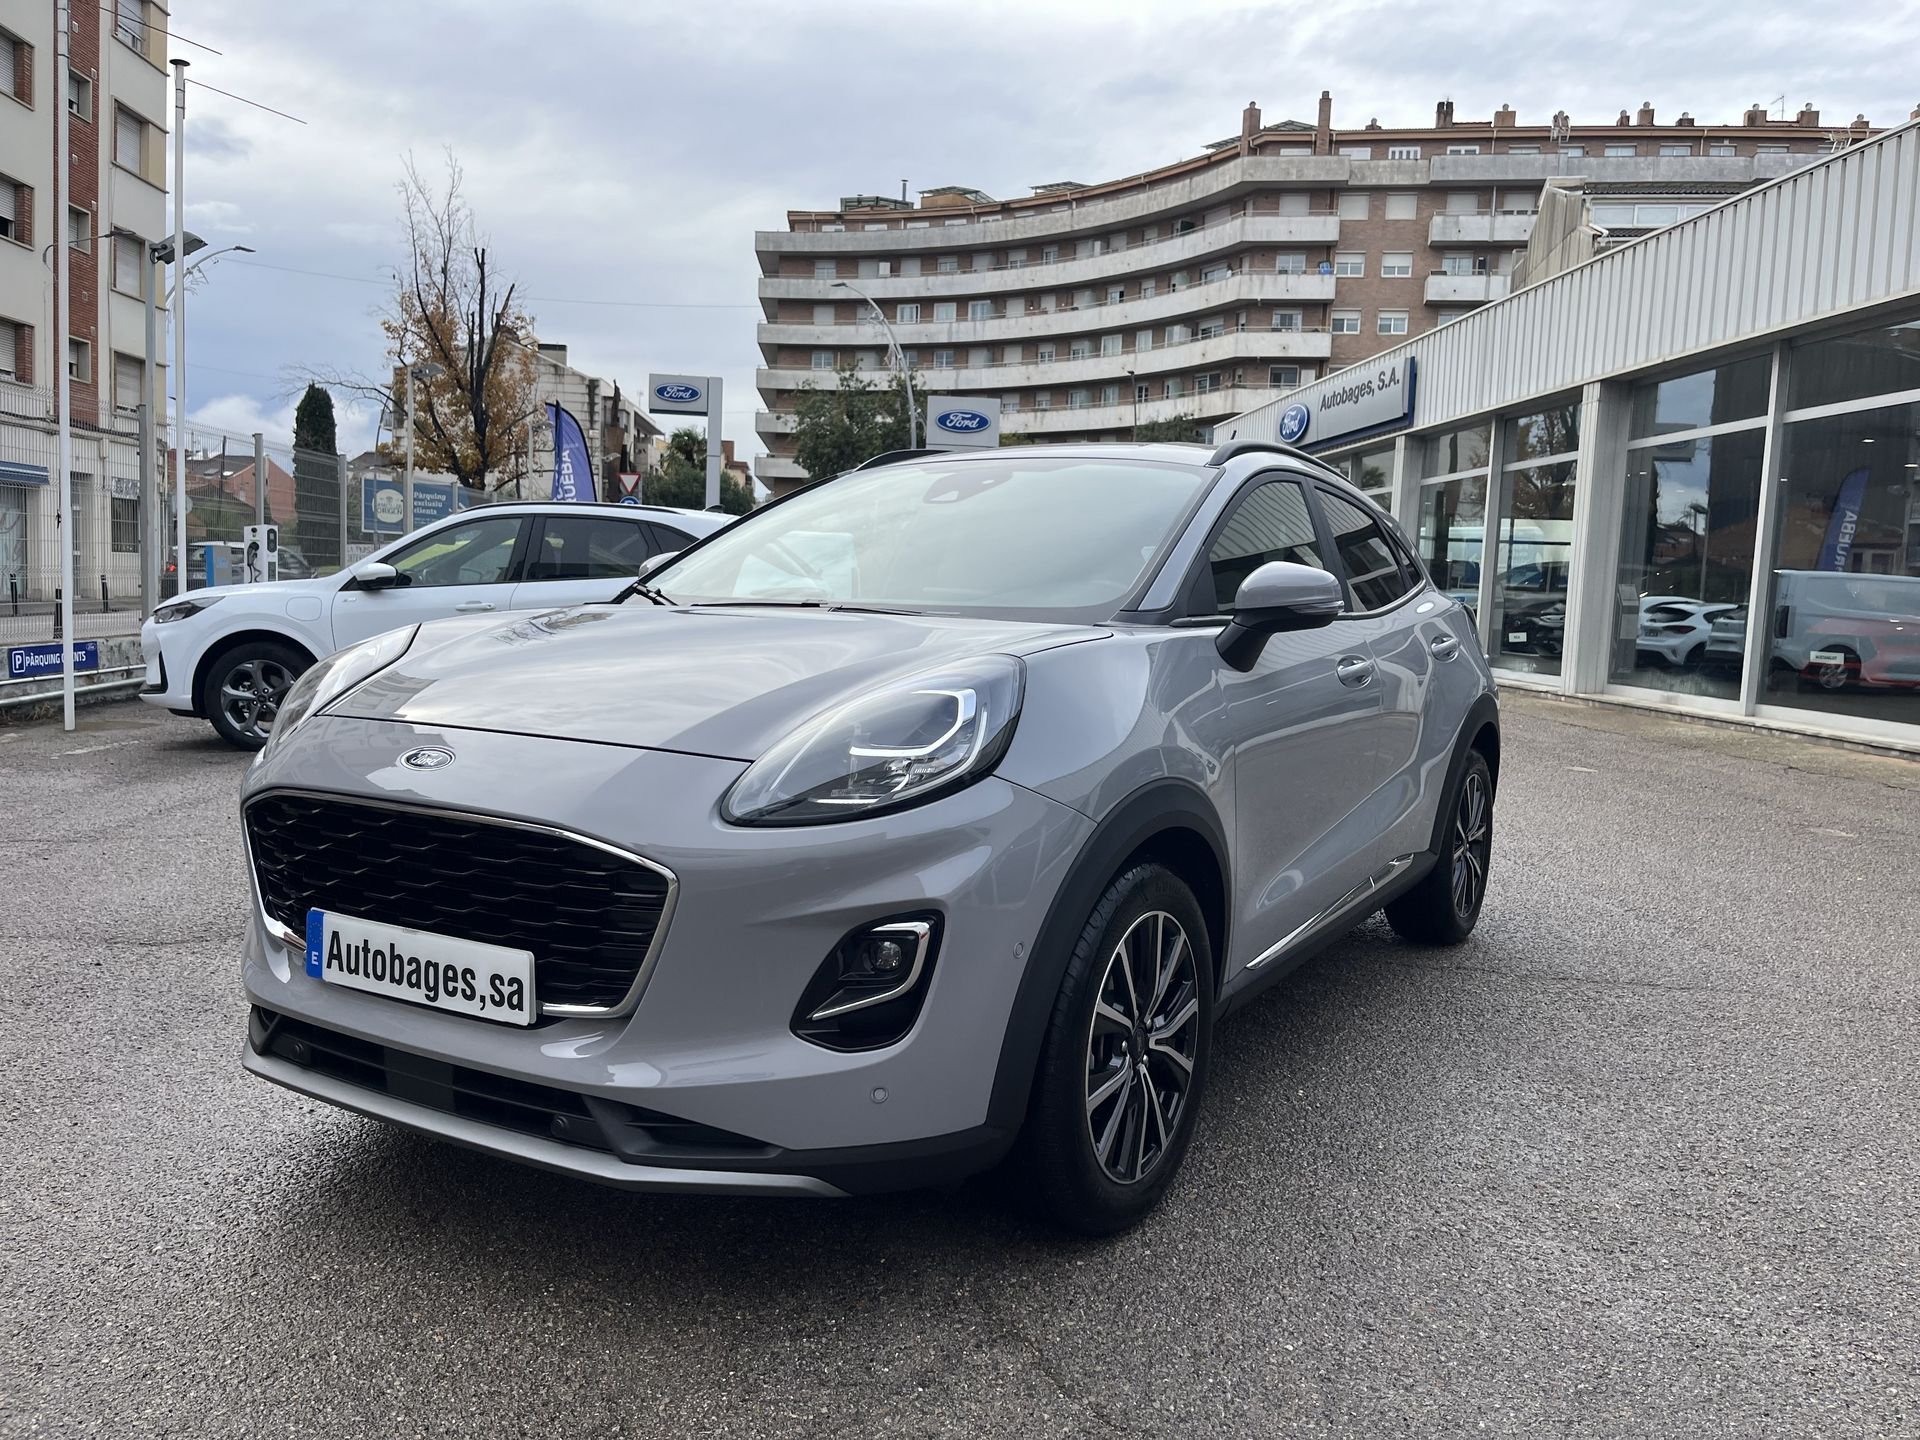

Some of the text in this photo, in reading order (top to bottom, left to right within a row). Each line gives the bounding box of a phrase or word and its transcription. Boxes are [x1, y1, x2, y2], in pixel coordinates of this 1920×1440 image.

[663, 385, 692, 398] Ford
[1320, 366, 1400, 412] Autobages, S.A.
[945, 412, 980, 428] Ford
[1282, 409, 1301, 436] Ford
[25, 652, 61, 667] PÀRQUING
[410, 750, 443, 766] Ford
[311, 951, 319, 966] E
[326, 930, 524, 1012] Autobages,sa
